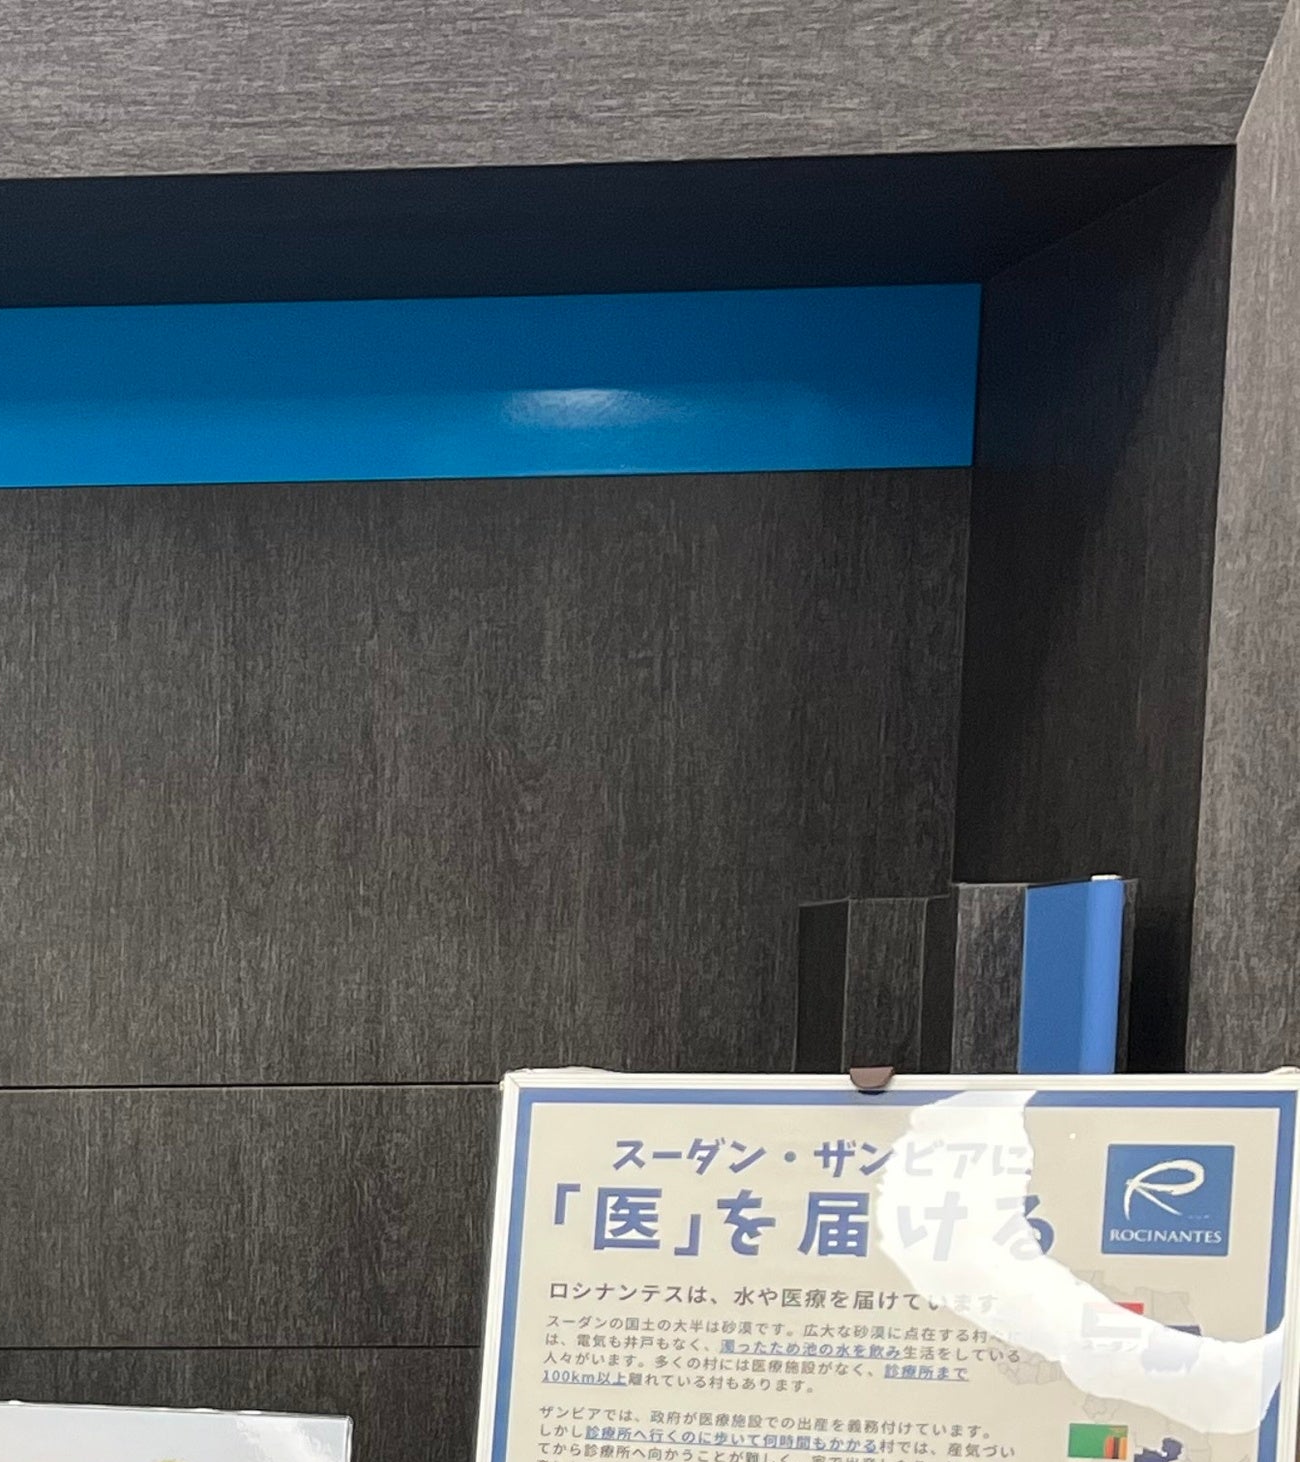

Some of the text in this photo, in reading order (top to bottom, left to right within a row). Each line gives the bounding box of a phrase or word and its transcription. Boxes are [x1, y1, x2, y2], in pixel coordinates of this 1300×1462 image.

[612, 1137, 1033, 1179] スーダン・ザンビアに
[552, 1183, 1056, 1261] 「医」を届ける
[1110, 1229, 1222, 1244] ROCINANTES
[545, 1333, 1021, 1364] は、電気も井戸もなく、濁ったため池の水を飲み生活をしている
[542, 1369, 814, 1394] 100km以上離れている村もあります。
[544, 1351, 969, 1381] 人々がいます。多くの村には医療施設がなく、診療所まで
[539, 1406, 990, 1440] ザンビアでは、政府が医療施設での出産を義務付けています。
[540, 1424, 1015, 1459] しかし診療所へ行くのに歩いて何時間もかかる村では、産気づい
